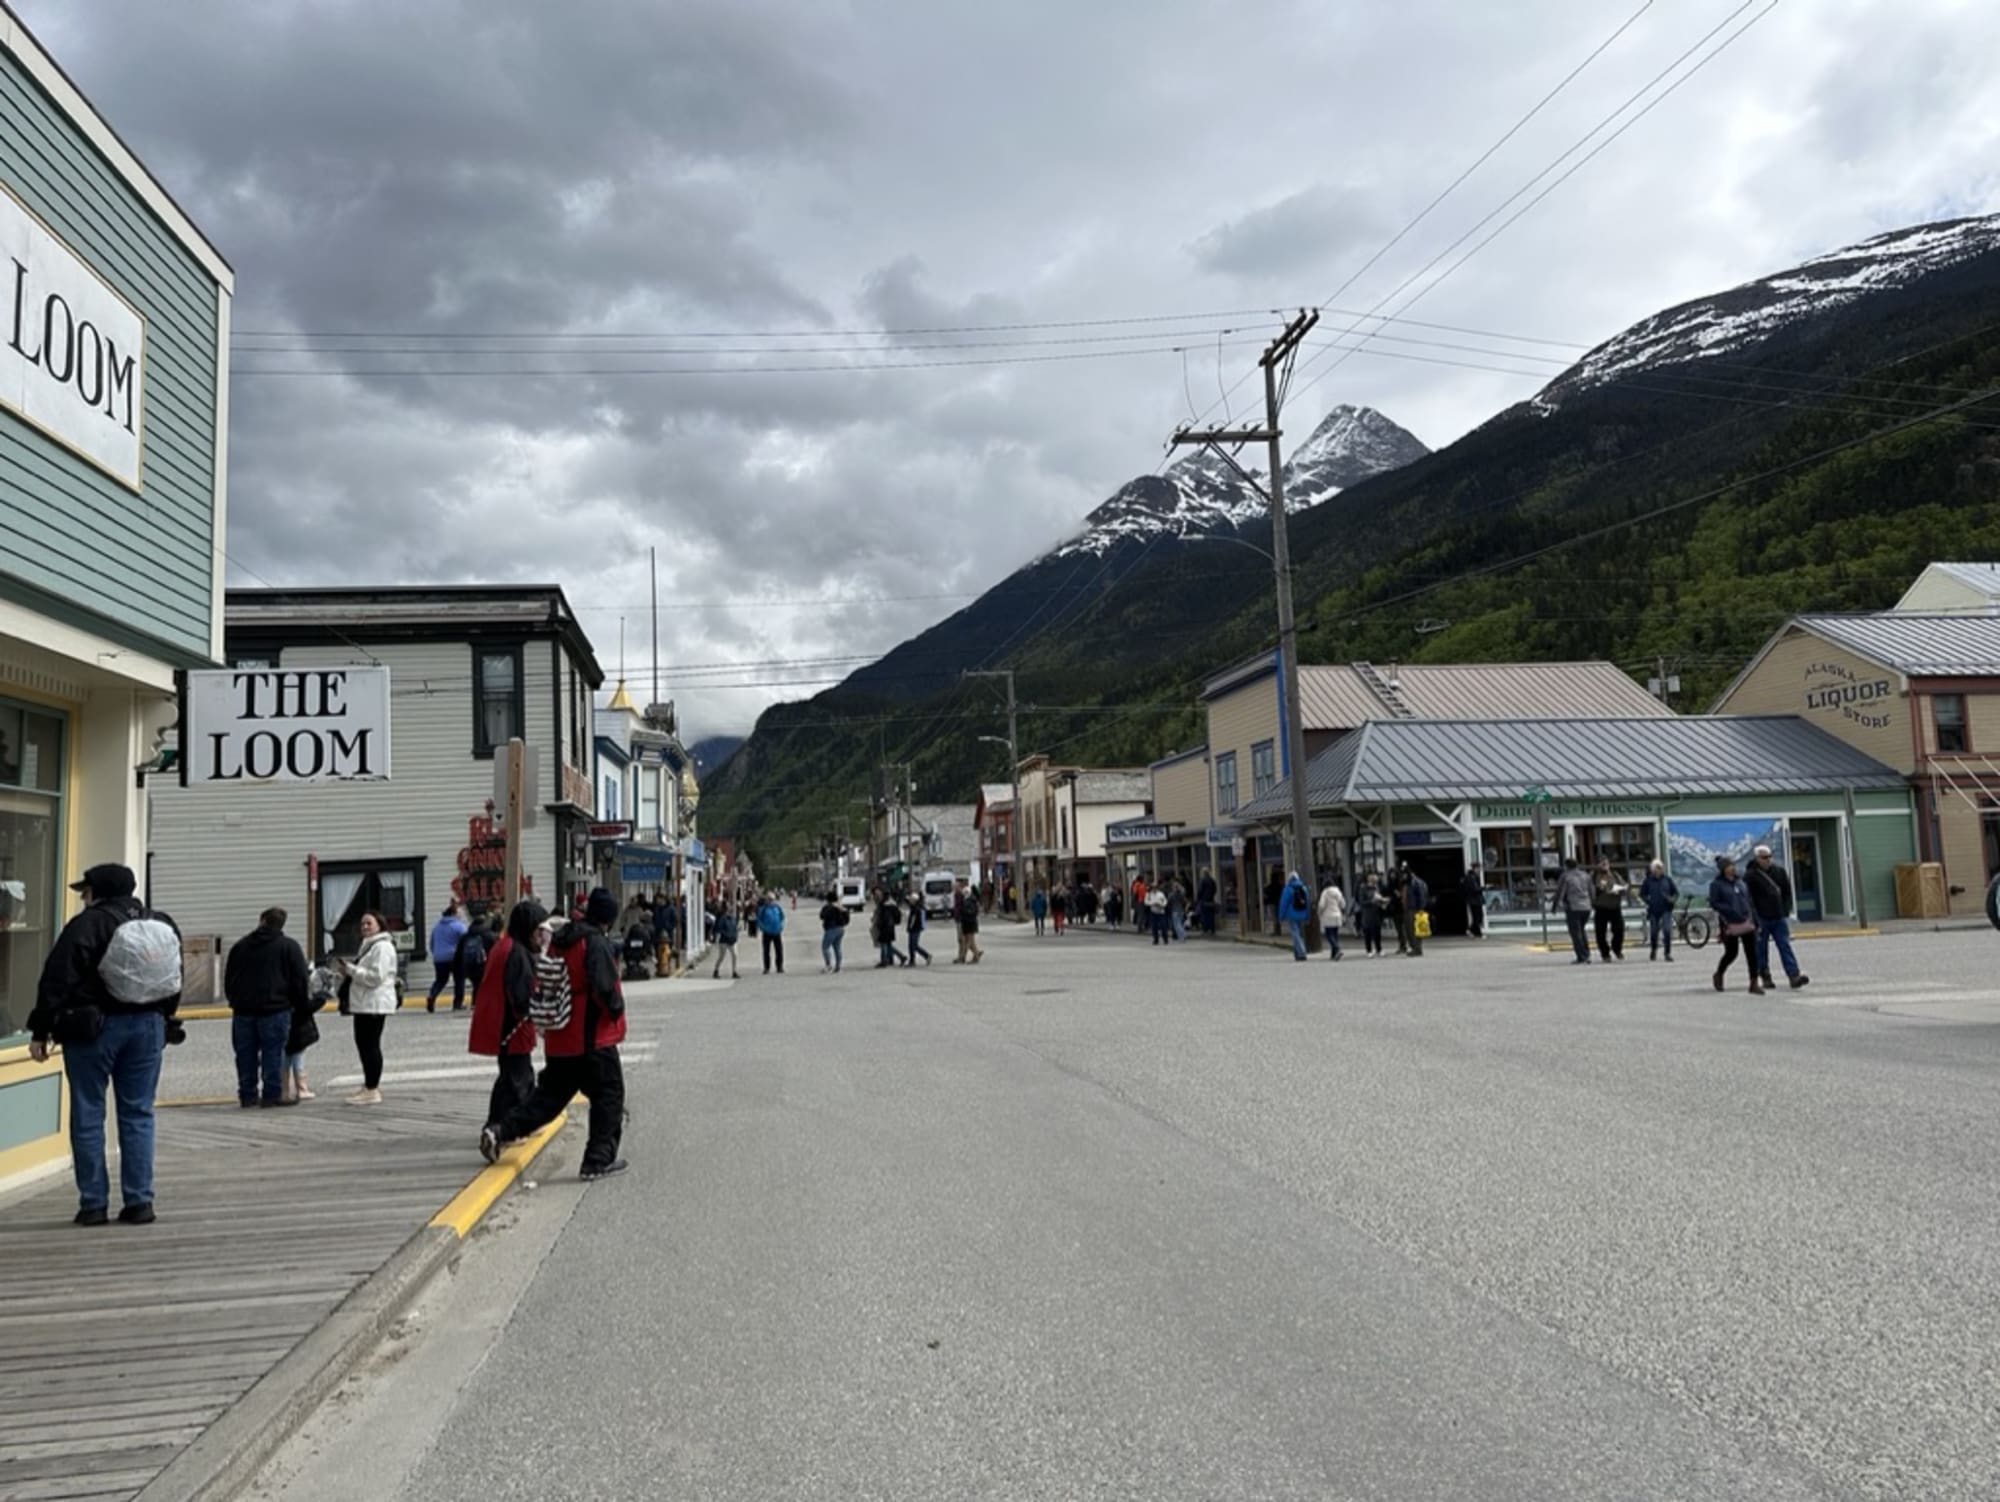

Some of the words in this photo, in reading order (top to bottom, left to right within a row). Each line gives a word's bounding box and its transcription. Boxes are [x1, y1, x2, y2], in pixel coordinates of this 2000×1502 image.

[8, 256, 136, 436] LOOM
[1804, 663, 1856, 682] ALASKA
[233, 671, 347, 720] THE
[1807, 680, 1892, 709] LIQUOR
[1843, 706, 1891, 728] STORE
[207, 728, 373, 780] LOOM
[1476, 801, 1568, 818] Diamds
[1580, 799, 1653, 816] Princess
